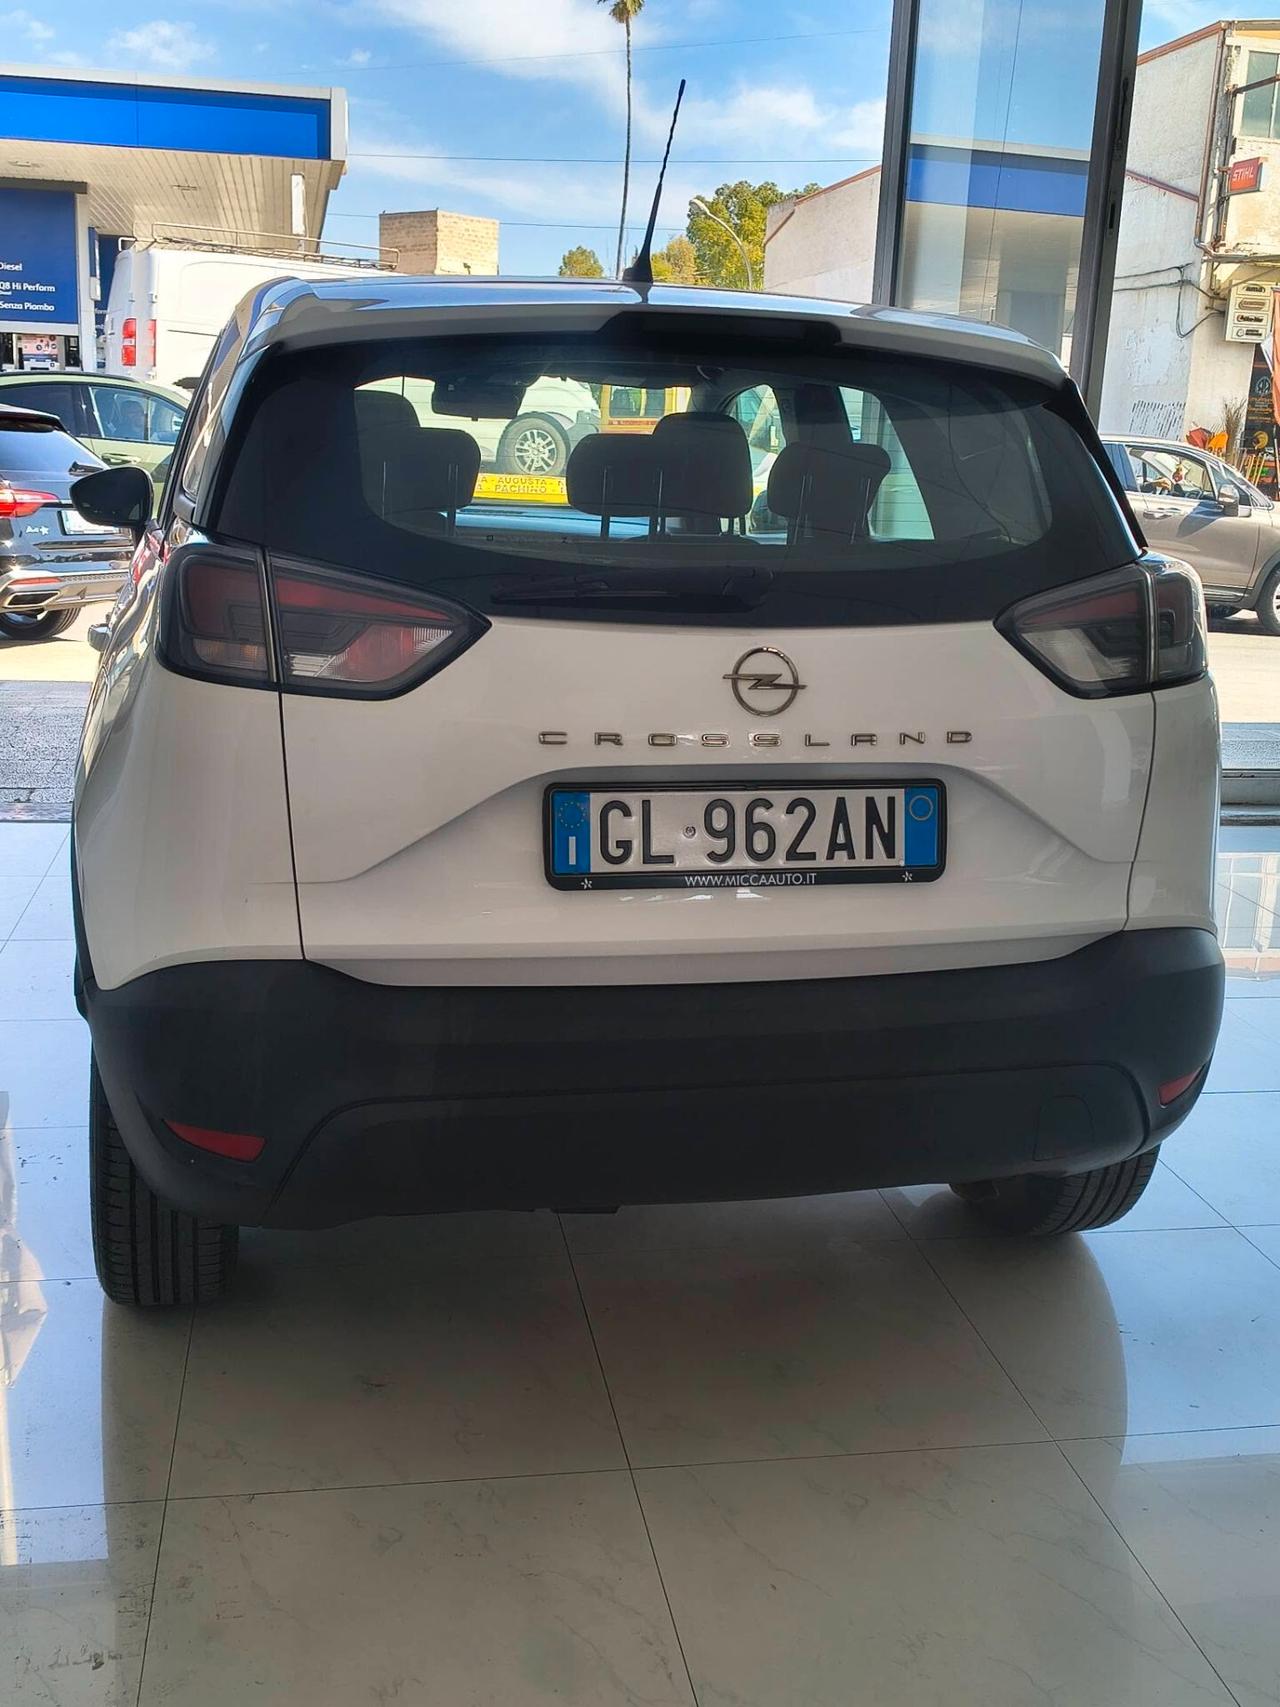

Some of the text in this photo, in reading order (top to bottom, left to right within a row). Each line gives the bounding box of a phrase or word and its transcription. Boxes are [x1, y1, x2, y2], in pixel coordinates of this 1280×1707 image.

[1232, 165, 1255, 181] STIHL
[12, 282, 22, 290] Hi
[23, 282, 56, 292] Perform
[24, 302, 55, 311] Piombo
[497, 477, 547, 486] AUGUSTA
[495, 484, 547, 494] PACHINO
[538, 730, 973, 748] CROSSLAND
[599, 795, 897, 866] GL 962AN
[684, 872, 817, 887] WWW.MICCAAUTO.IT
